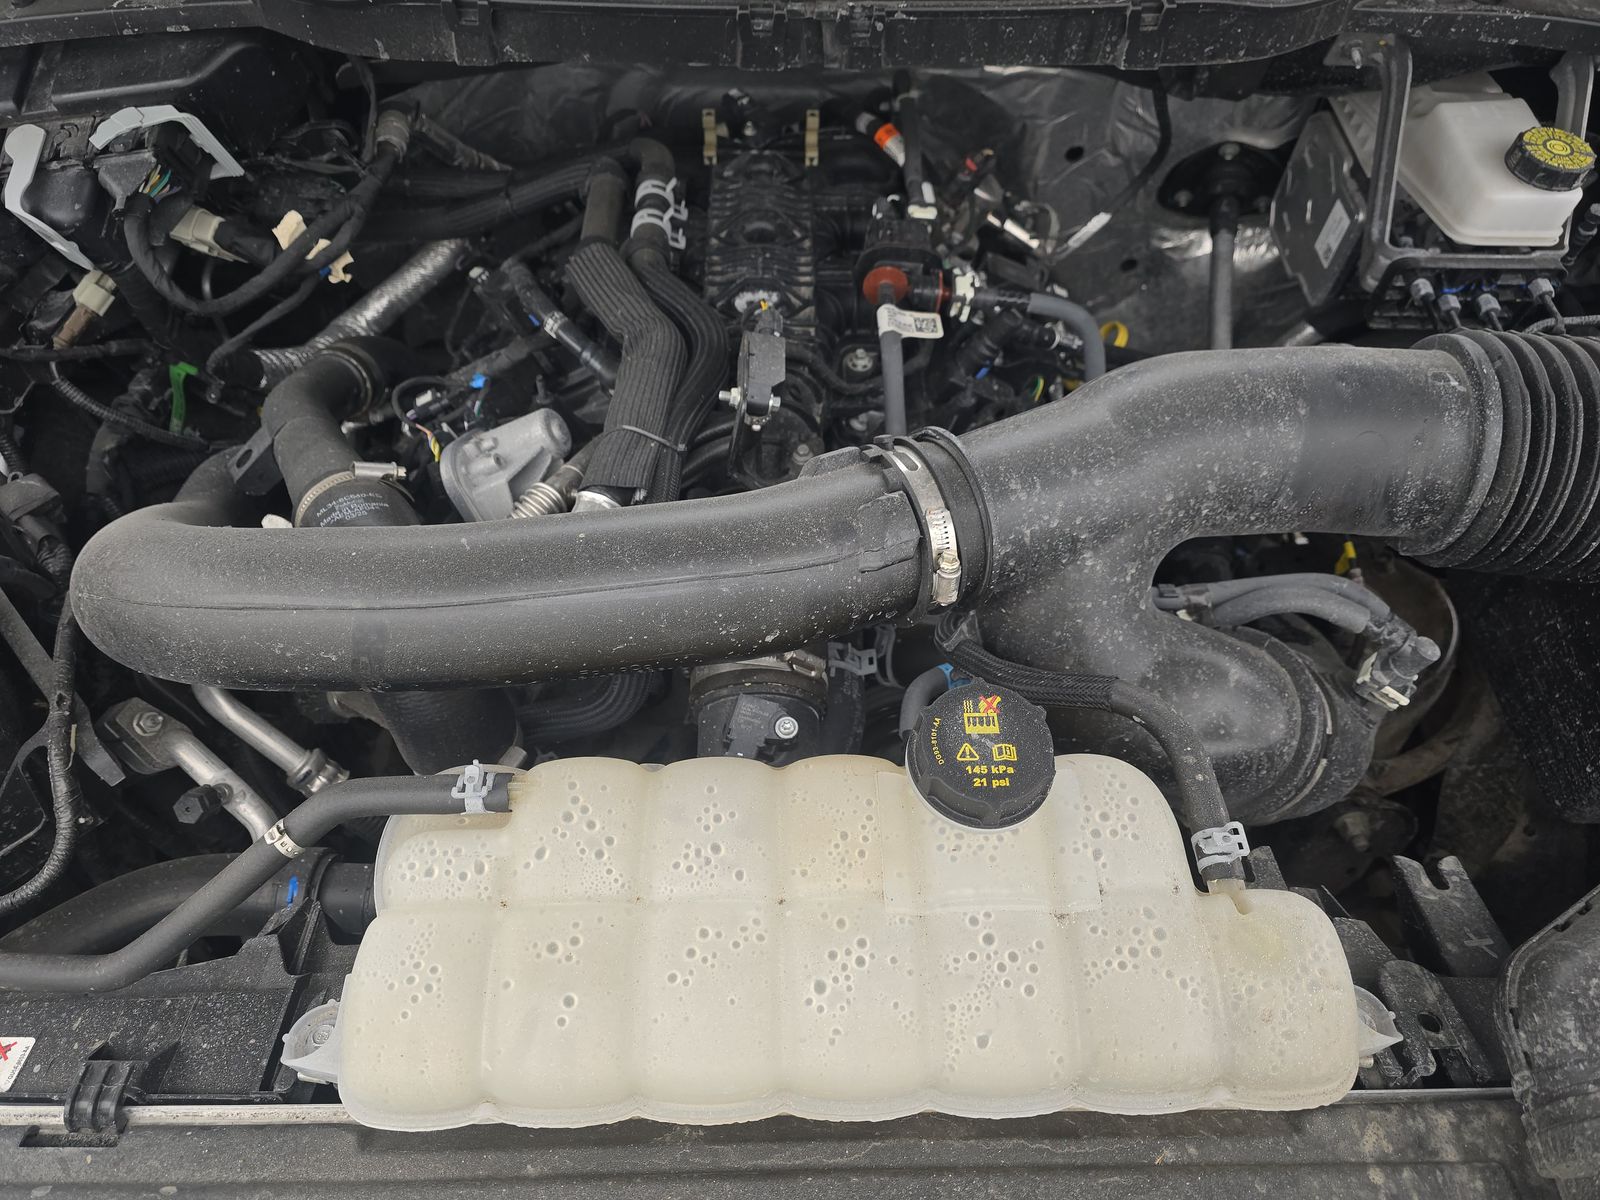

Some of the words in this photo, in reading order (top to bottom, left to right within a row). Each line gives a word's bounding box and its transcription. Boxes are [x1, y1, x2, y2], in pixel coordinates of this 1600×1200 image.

[320, 510, 340, 527] Made
[965, 765, 988, 774] 145
[991, 765, 1014, 774] kPa
[973, 778, 987, 787] 21
[992, 778, 1009, 788] psi
